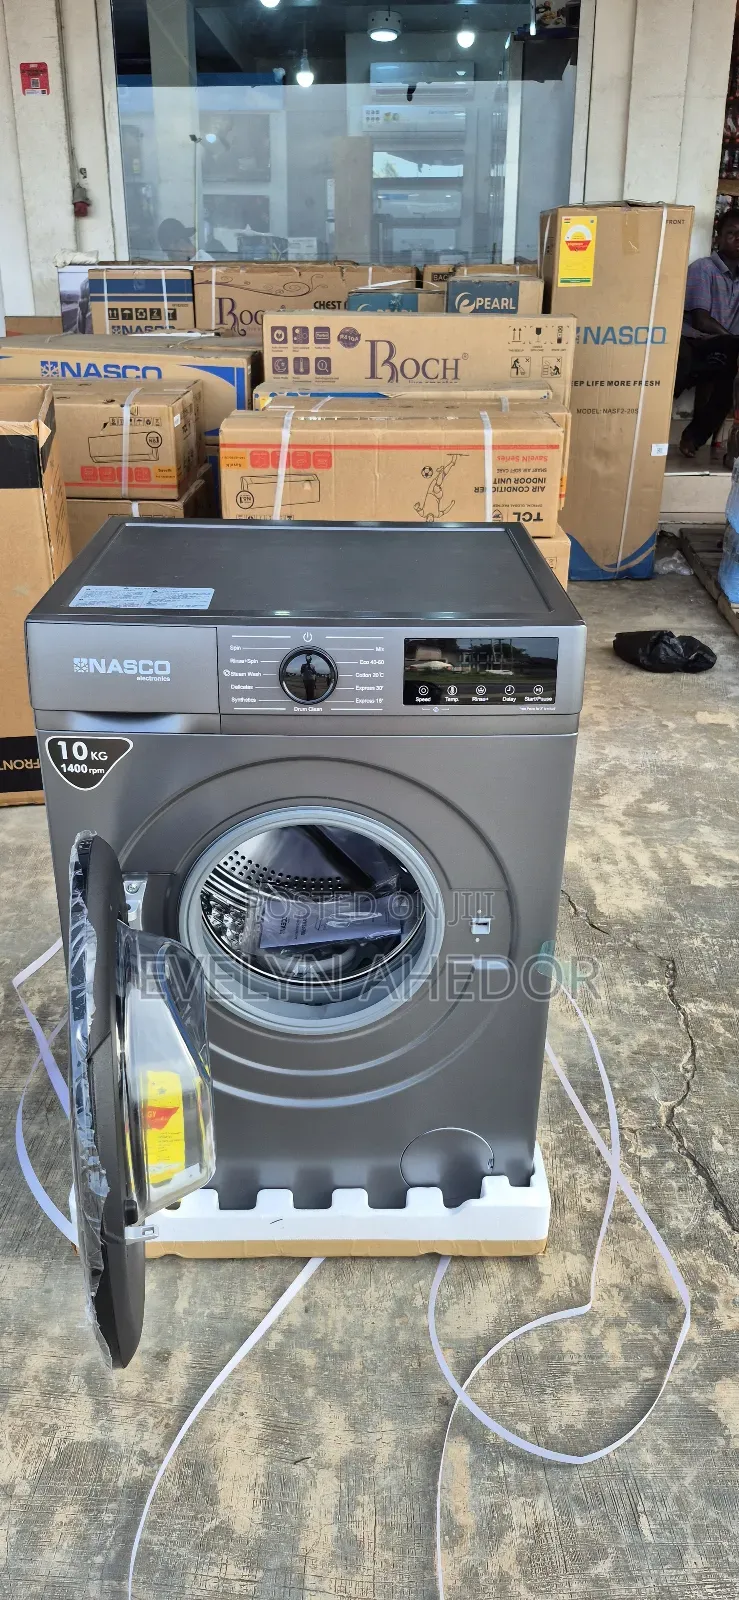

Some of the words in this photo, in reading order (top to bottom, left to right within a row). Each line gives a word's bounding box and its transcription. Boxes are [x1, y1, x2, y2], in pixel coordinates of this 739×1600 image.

[313, 300, 342, 310] CHEST
[475, 297, 516, 310] PEARL
[214, 297, 265, 337] ROC
[121, 325, 176, 335] NAS
[582, 326, 667, 345] NASCO
[60, 361, 163, 379] NASCO
[496, 455, 520, 463] Series
[492, 477, 512, 485] UNIT
[513, 477, 547, 485] INDOOR
[473, 485, 530, 493] CONDITIOER
[531, 485, 546, 493] AIR
[512, 511, 544, 523] TCL
[229, 644, 242, 652] Spin
[89, 658, 171, 675] NASCO
[57, 740, 89, 761] 10
[90, 750, 109, 761] KG
[60, 763, 88, 773] 1400
[88, 767, 105, 775] rpm
